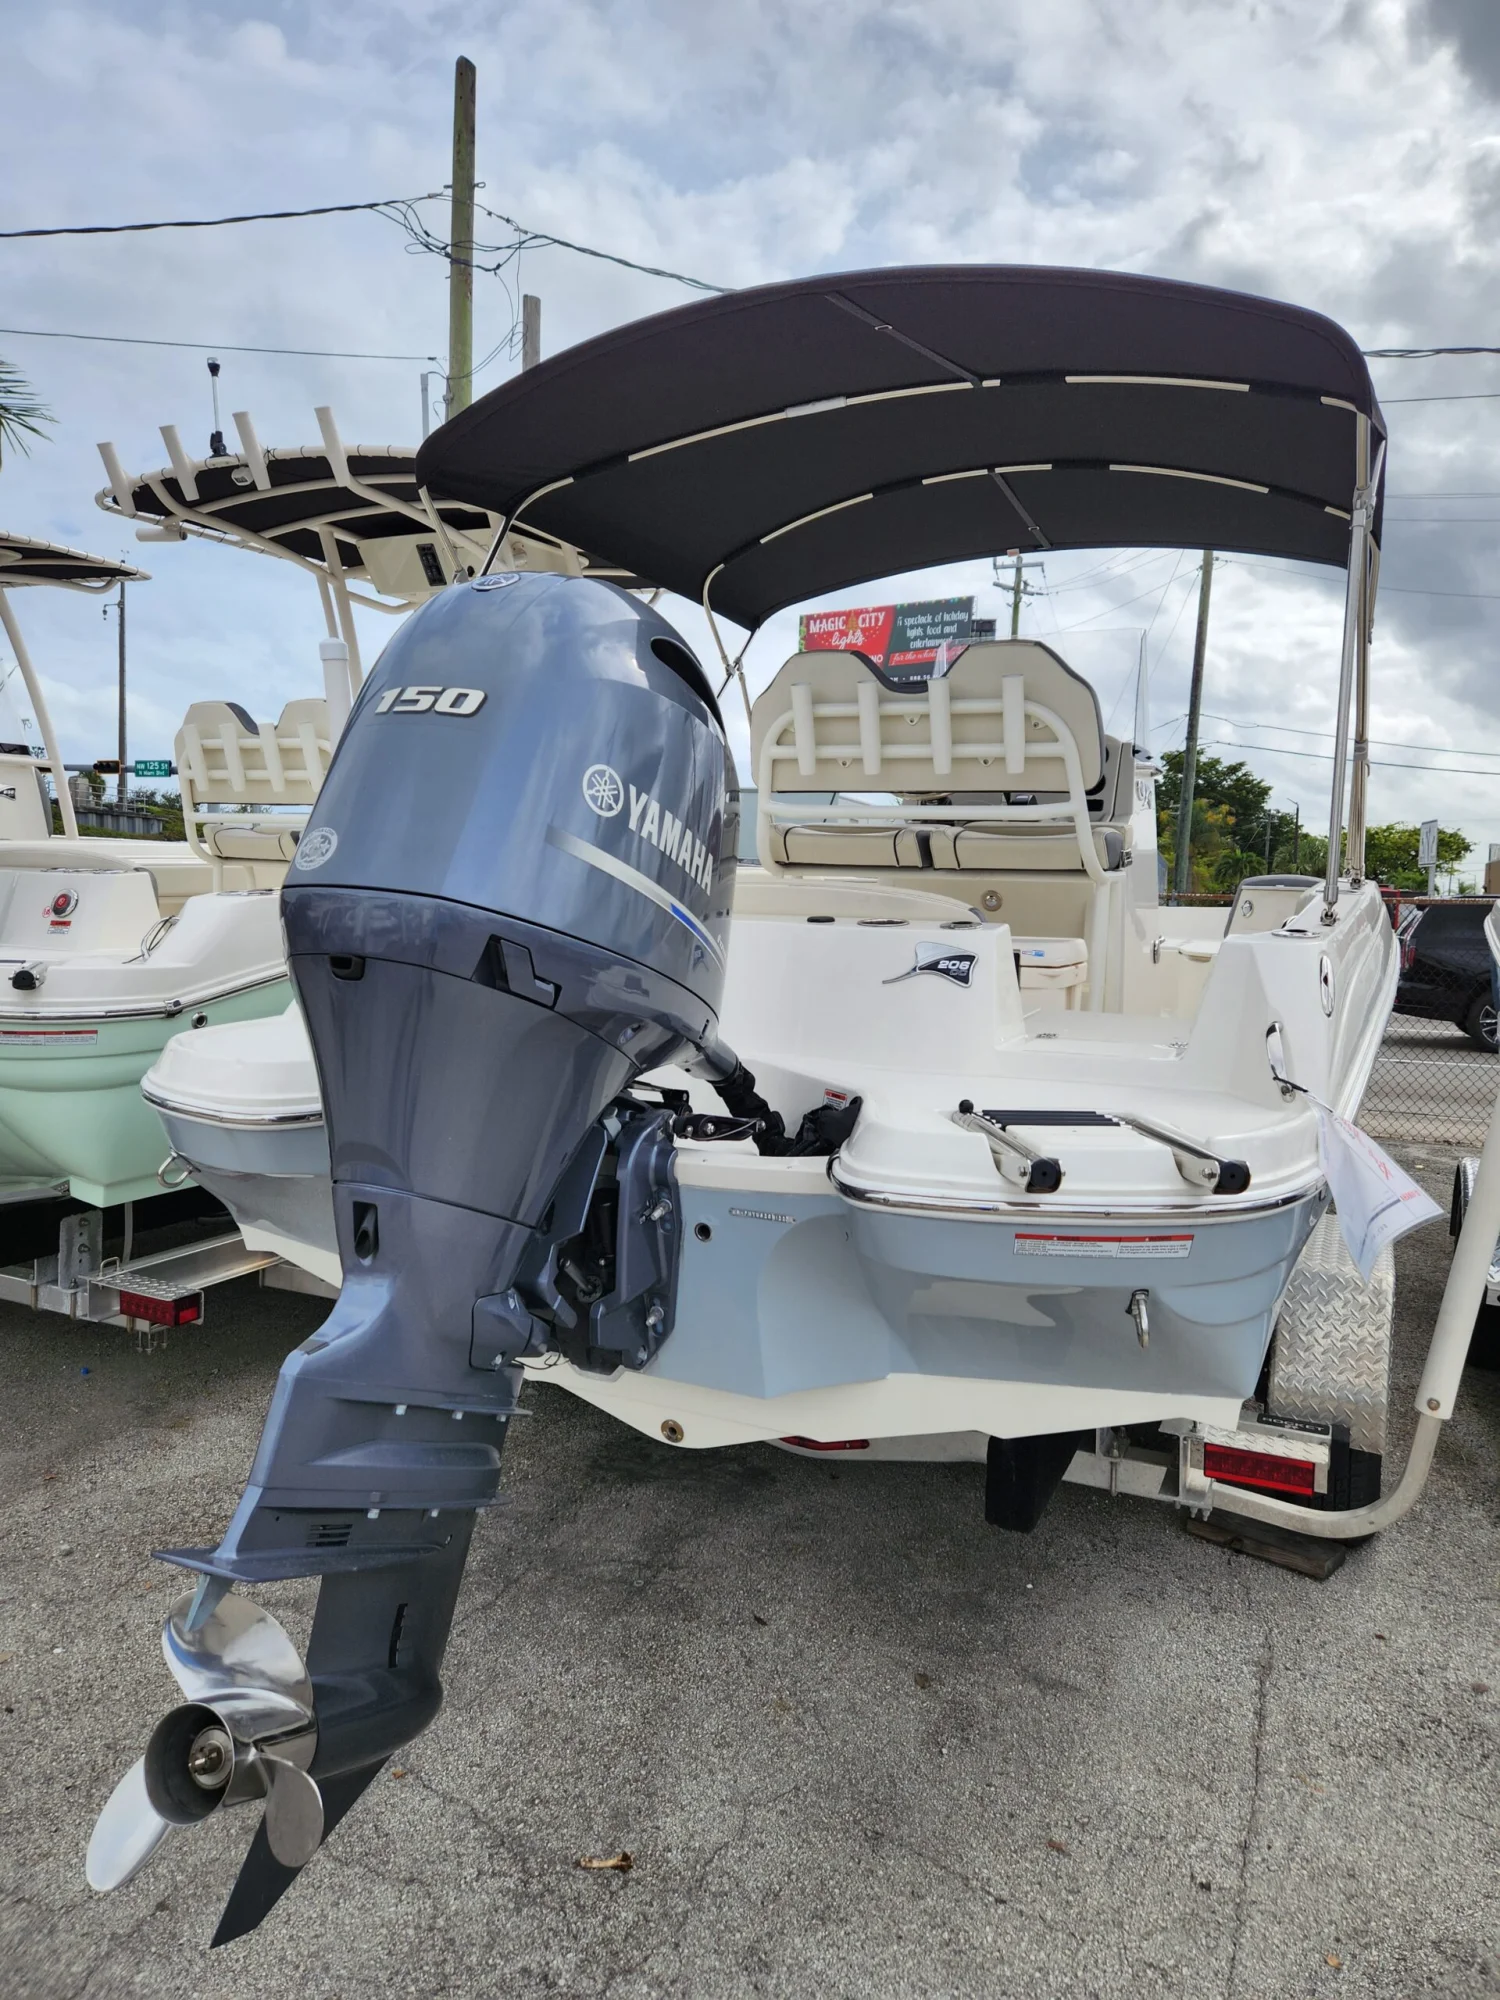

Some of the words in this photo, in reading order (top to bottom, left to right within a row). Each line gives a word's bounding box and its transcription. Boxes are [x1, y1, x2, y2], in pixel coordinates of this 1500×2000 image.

[810, 616, 846, 633] MAGIC
[858, 611, 885, 628] CITY
[904, 614, 932, 627] spectacle
[935, 612, 942, 622] of
[944, 610, 968, 622] holiday
[927, 625, 941, 635] food
[944, 623, 957, 633] and
[831, 629, 864, 650] lights
[905, 651, 914, 659] the
[375, 686, 486, 715] 150
[147, 762, 159, 770] 125
[628, 783, 714, 896] YAMAHA
[938, 960, 970, 969] 206
